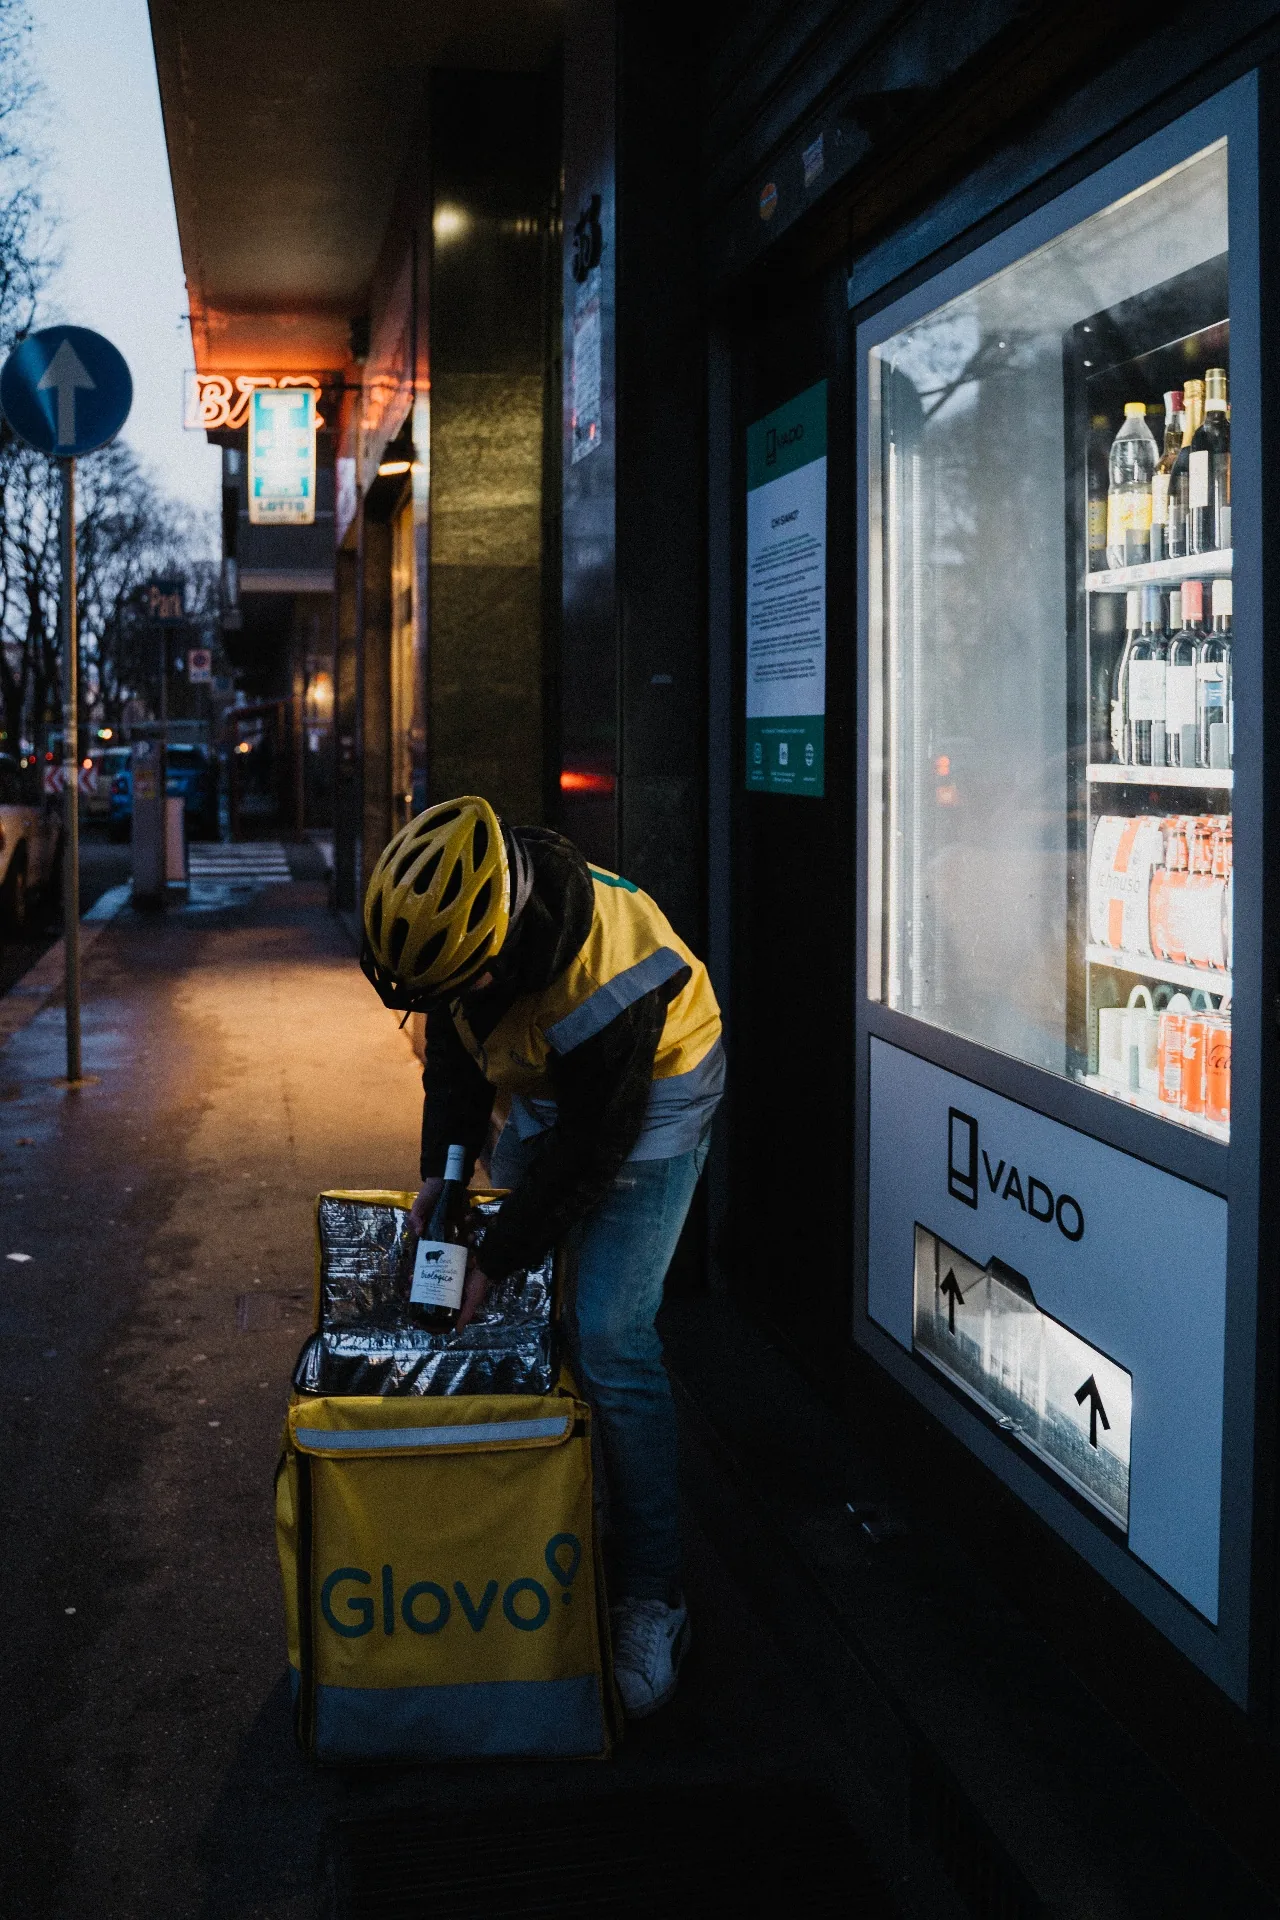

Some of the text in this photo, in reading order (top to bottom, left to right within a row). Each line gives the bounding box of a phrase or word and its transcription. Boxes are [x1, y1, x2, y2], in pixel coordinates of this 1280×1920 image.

[778, 424, 804, 448] VADO
[258, 500, 306, 512] LOTTO
[981, 1149, 1086, 1242] VADO
[421, 1269, 453, 1283] biologico
[321, 1563, 552, 1639] Glovo
